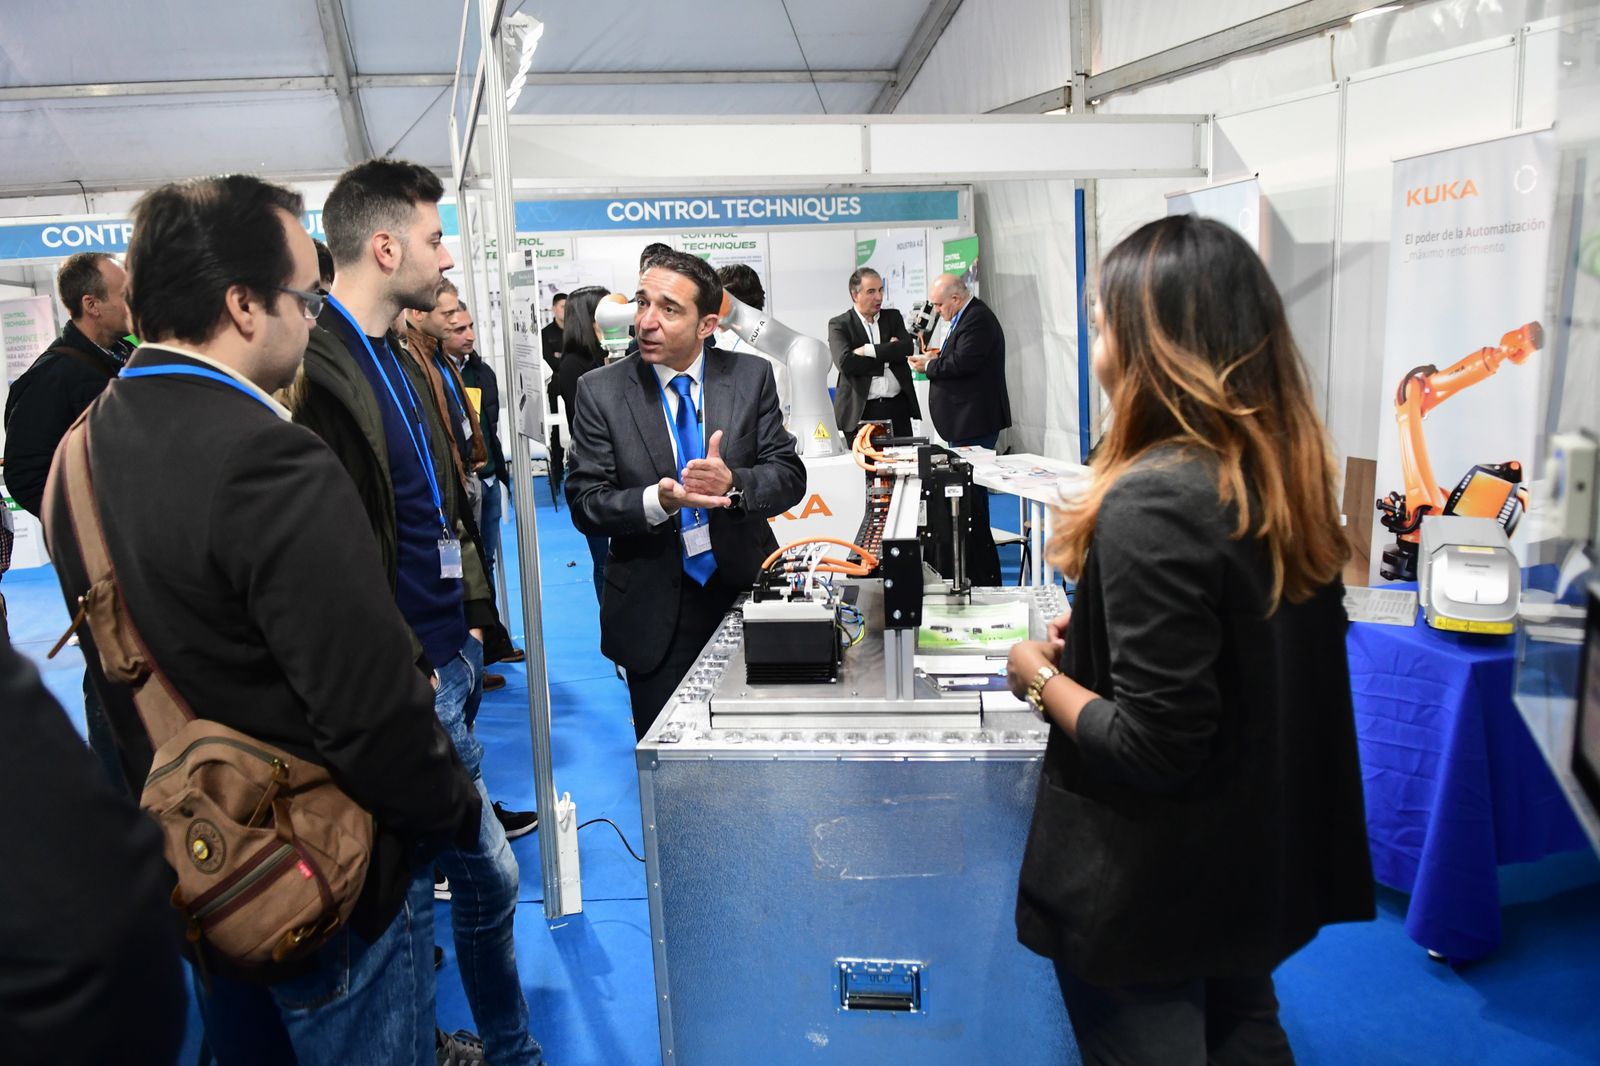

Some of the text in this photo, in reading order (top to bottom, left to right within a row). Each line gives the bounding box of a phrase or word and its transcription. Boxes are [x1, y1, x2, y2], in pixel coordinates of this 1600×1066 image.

[1406, 179, 1479, 208] KUKA
[606, 196, 862, 222] CONTROL TECHNIQUES
[41, 223, 134, 248] CONTR
[1405, 218, 1545, 246] El poder de la Automatización
[683, 241, 757, 250] TECHNIQUES
[1446, 242, 1505, 258] rendimiento
